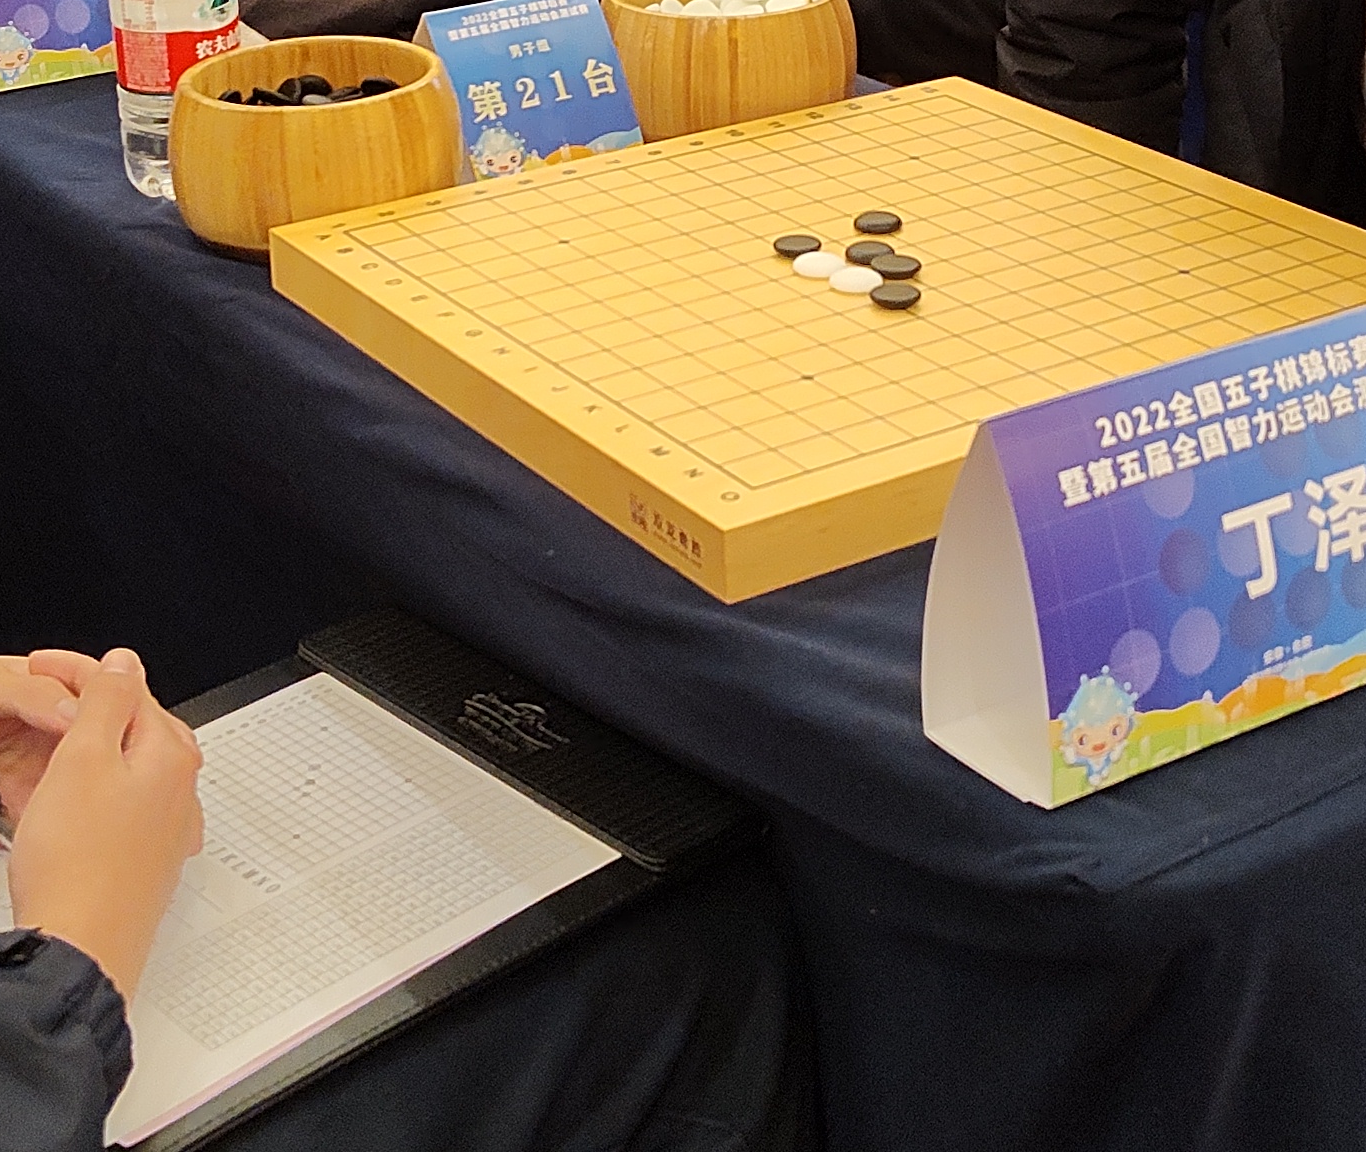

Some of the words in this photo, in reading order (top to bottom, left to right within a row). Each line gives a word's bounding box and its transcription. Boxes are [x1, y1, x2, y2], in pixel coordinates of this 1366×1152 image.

[508, 38, 552, 59] 男子组
[467, 58, 618, 123] 第21台
